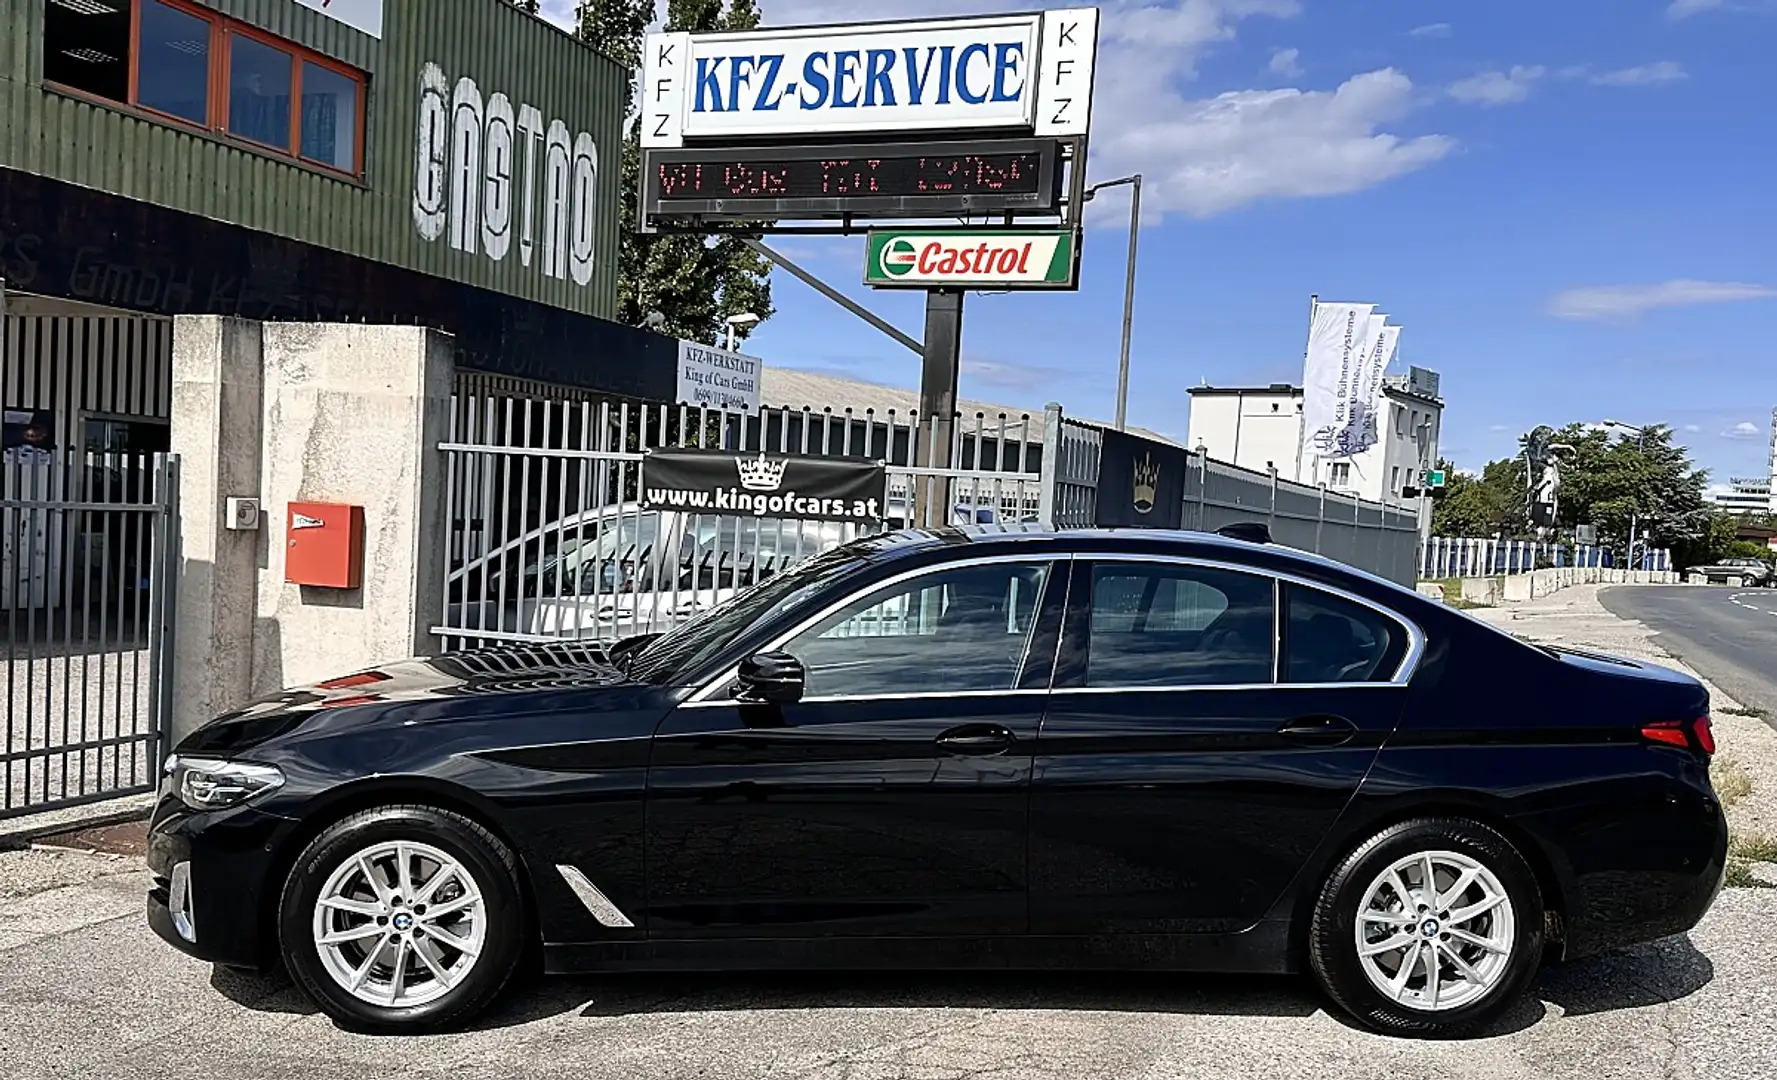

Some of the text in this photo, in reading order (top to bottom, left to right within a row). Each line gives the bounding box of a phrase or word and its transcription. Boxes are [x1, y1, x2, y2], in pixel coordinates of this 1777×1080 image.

[652, 44, 676, 138] KFZ
[692, 41, 1025, 114] KFZ-SERVICE
[1052, 22, 1078, 125] KFZ
[917, 241, 1032, 276] Castrol
[686, 346, 755, 375] KFZ-WERKSTATT
[685, 366, 754, 392] King of Cars GmbH
[646, 487, 879, 518] www.kingofcars.at
